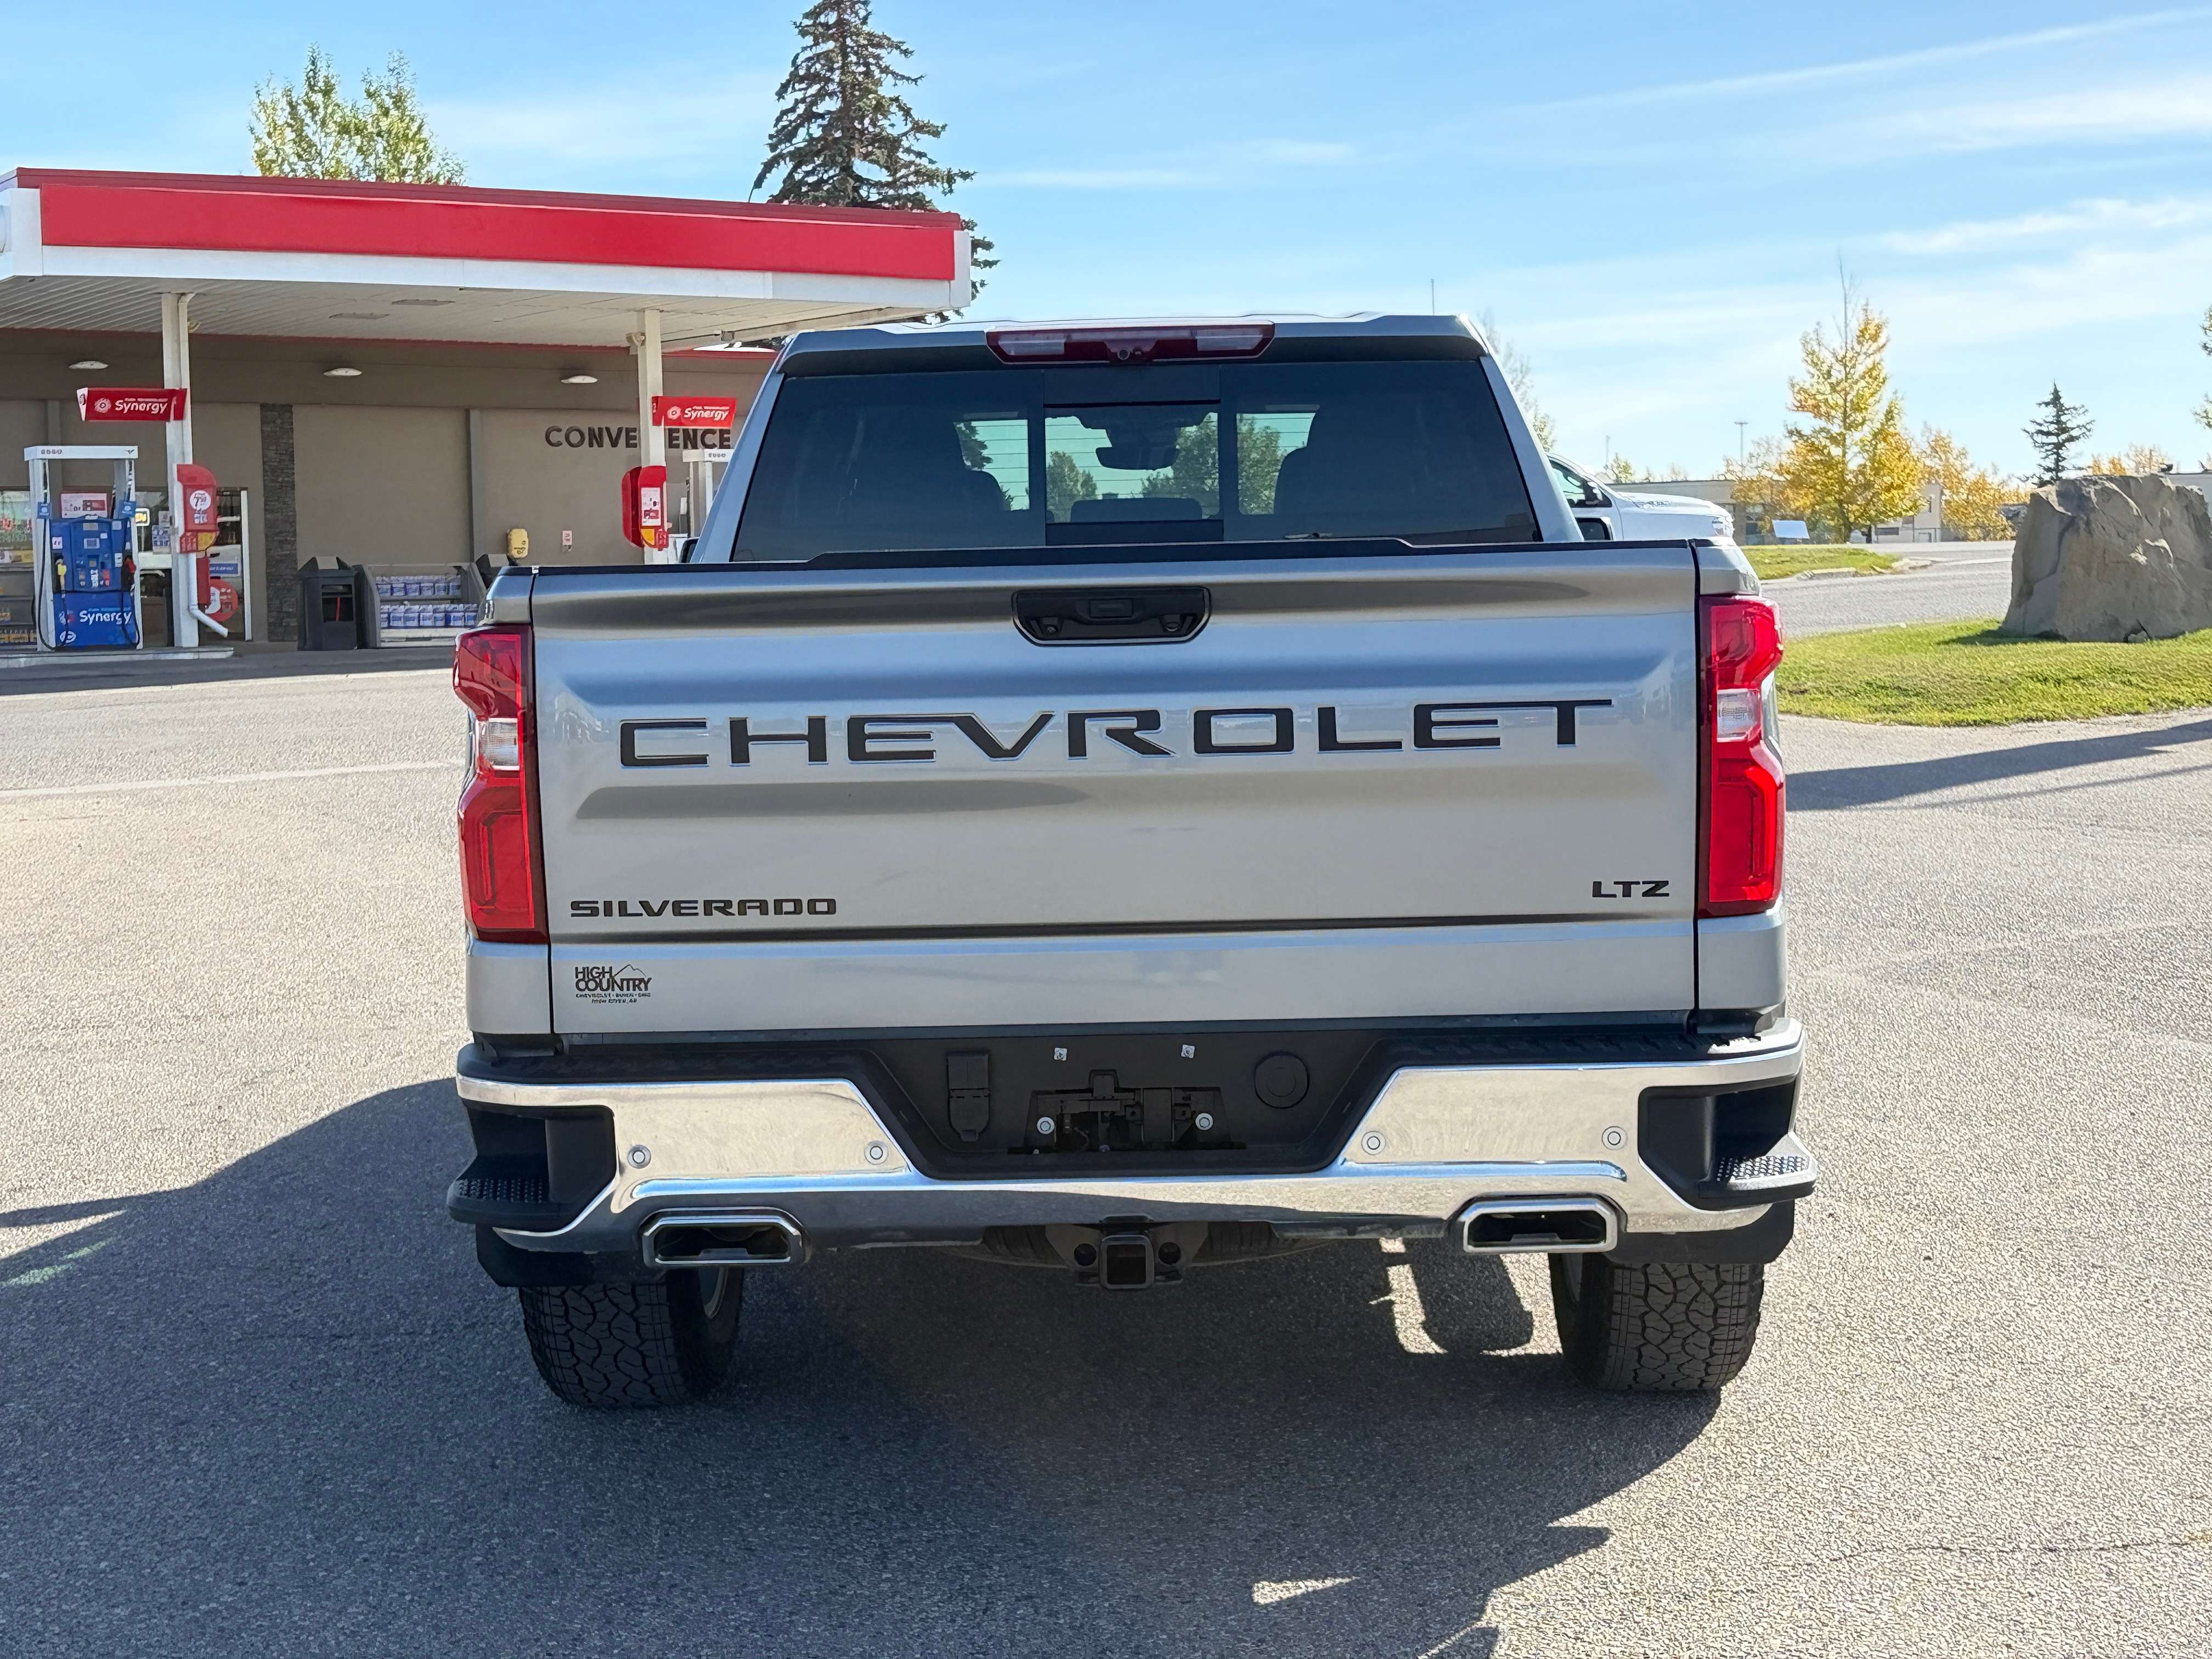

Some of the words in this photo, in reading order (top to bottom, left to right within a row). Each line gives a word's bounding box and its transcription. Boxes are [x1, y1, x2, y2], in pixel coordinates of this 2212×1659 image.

[115, 400, 168, 414] Synergy
[684, 408, 730, 421] Synergy
[545, 426, 731, 449] CONVEENCE
[619, 699, 1612, 766] CHEVROLET
[1592, 881, 1669, 898] LTZ
[571, 898, 837, 917] SILVERADO
[575, 966, 613, 979] HIGH
[575, 977, 652, 992] COUNTRY
